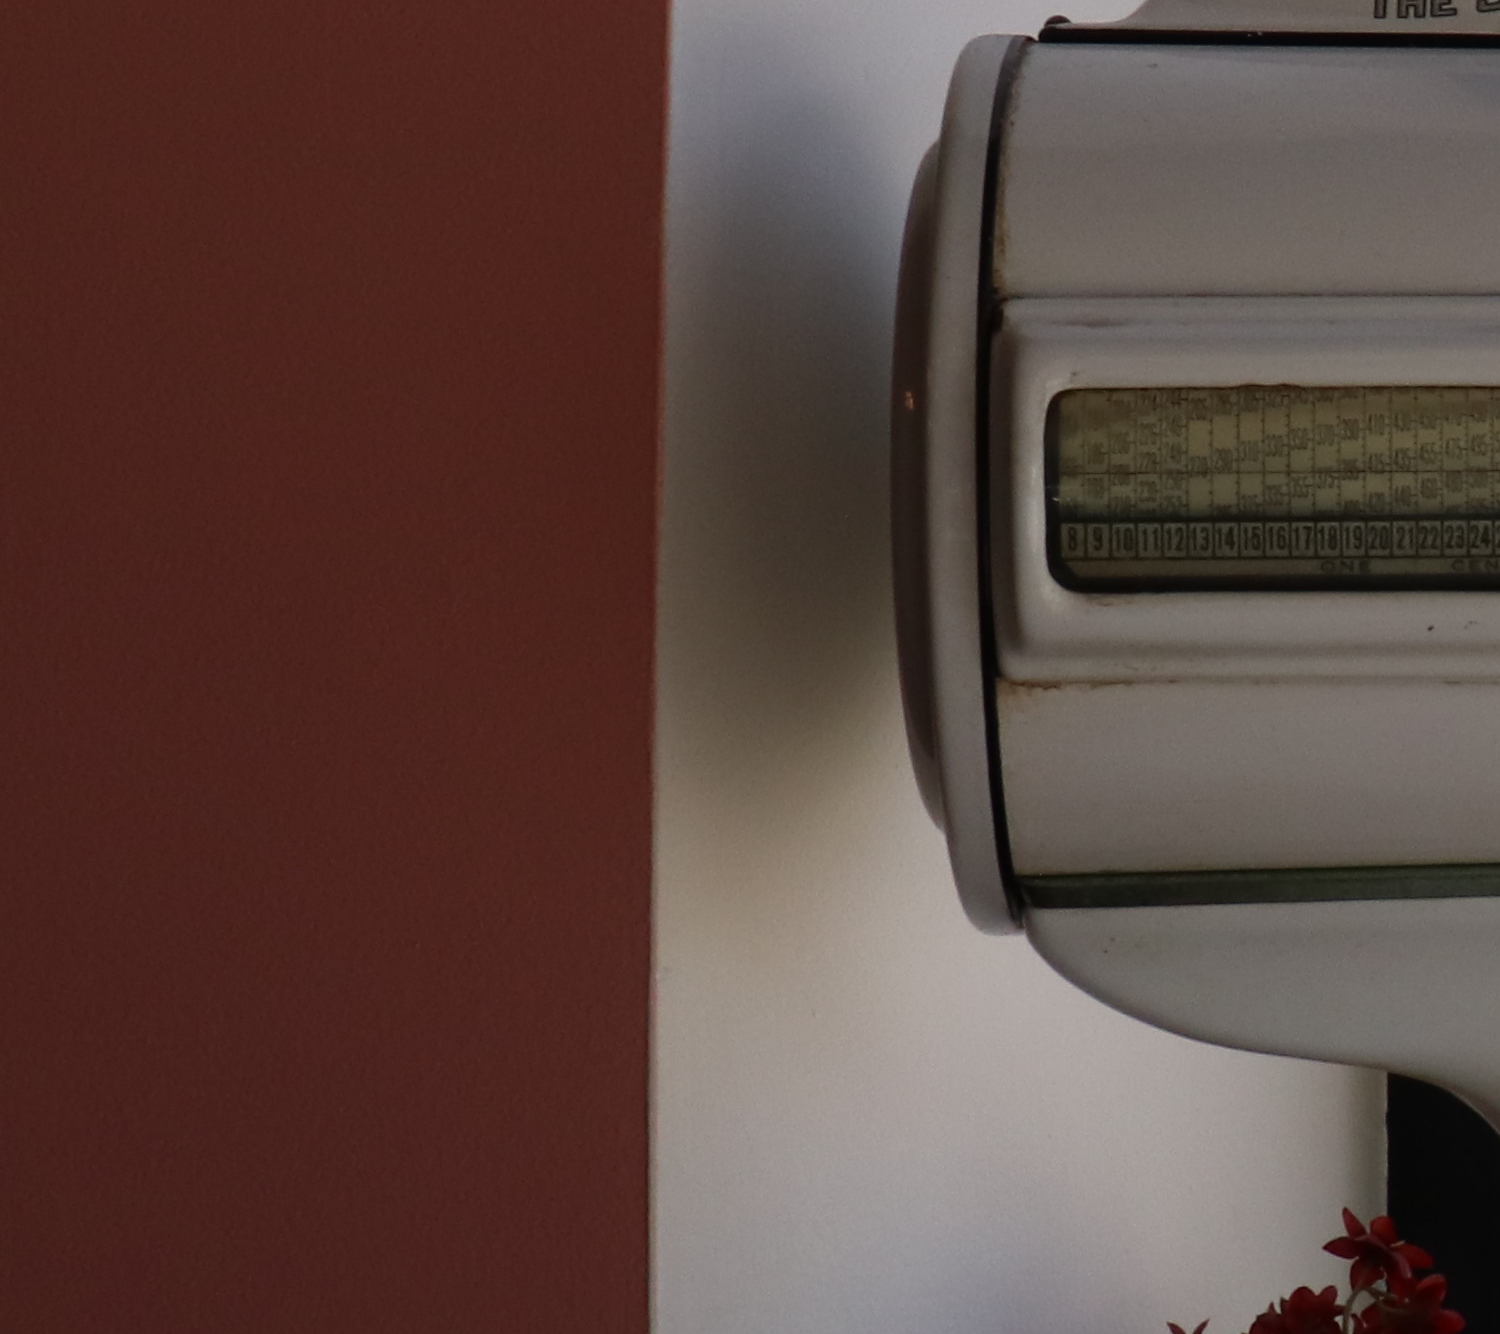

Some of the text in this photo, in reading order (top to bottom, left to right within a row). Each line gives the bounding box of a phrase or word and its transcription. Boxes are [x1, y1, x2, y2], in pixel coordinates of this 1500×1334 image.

[1067, 527, 1078, 553] 8
[1093, 526, 1104, 552] 9
[1115, 526, 1133, 552] 10
[1142, 526, 1160, 552] 11
[1166, 526, 1185, 552] 12
[1191, 526, 1211, 552] 13
[1217, 526, 1236, 552] 14
[1243, 526, 1262, 551] 15
[1268, 526, 1287, 551] 16
[1293, 525, 1313, 551] 17
[1318, 525, 1337, 551] 18
[1344, 525, 1363, 551] 19
[1369, 525, 1389, 551] 20
[1396, 525, 1414, 550] 21
[1419, 525, 1439, 550] 22
[1445, 525, 1465, 550] 23
[1470, 525, 1491, 550] 24
[1320, 560, 1371, 574] ONE
